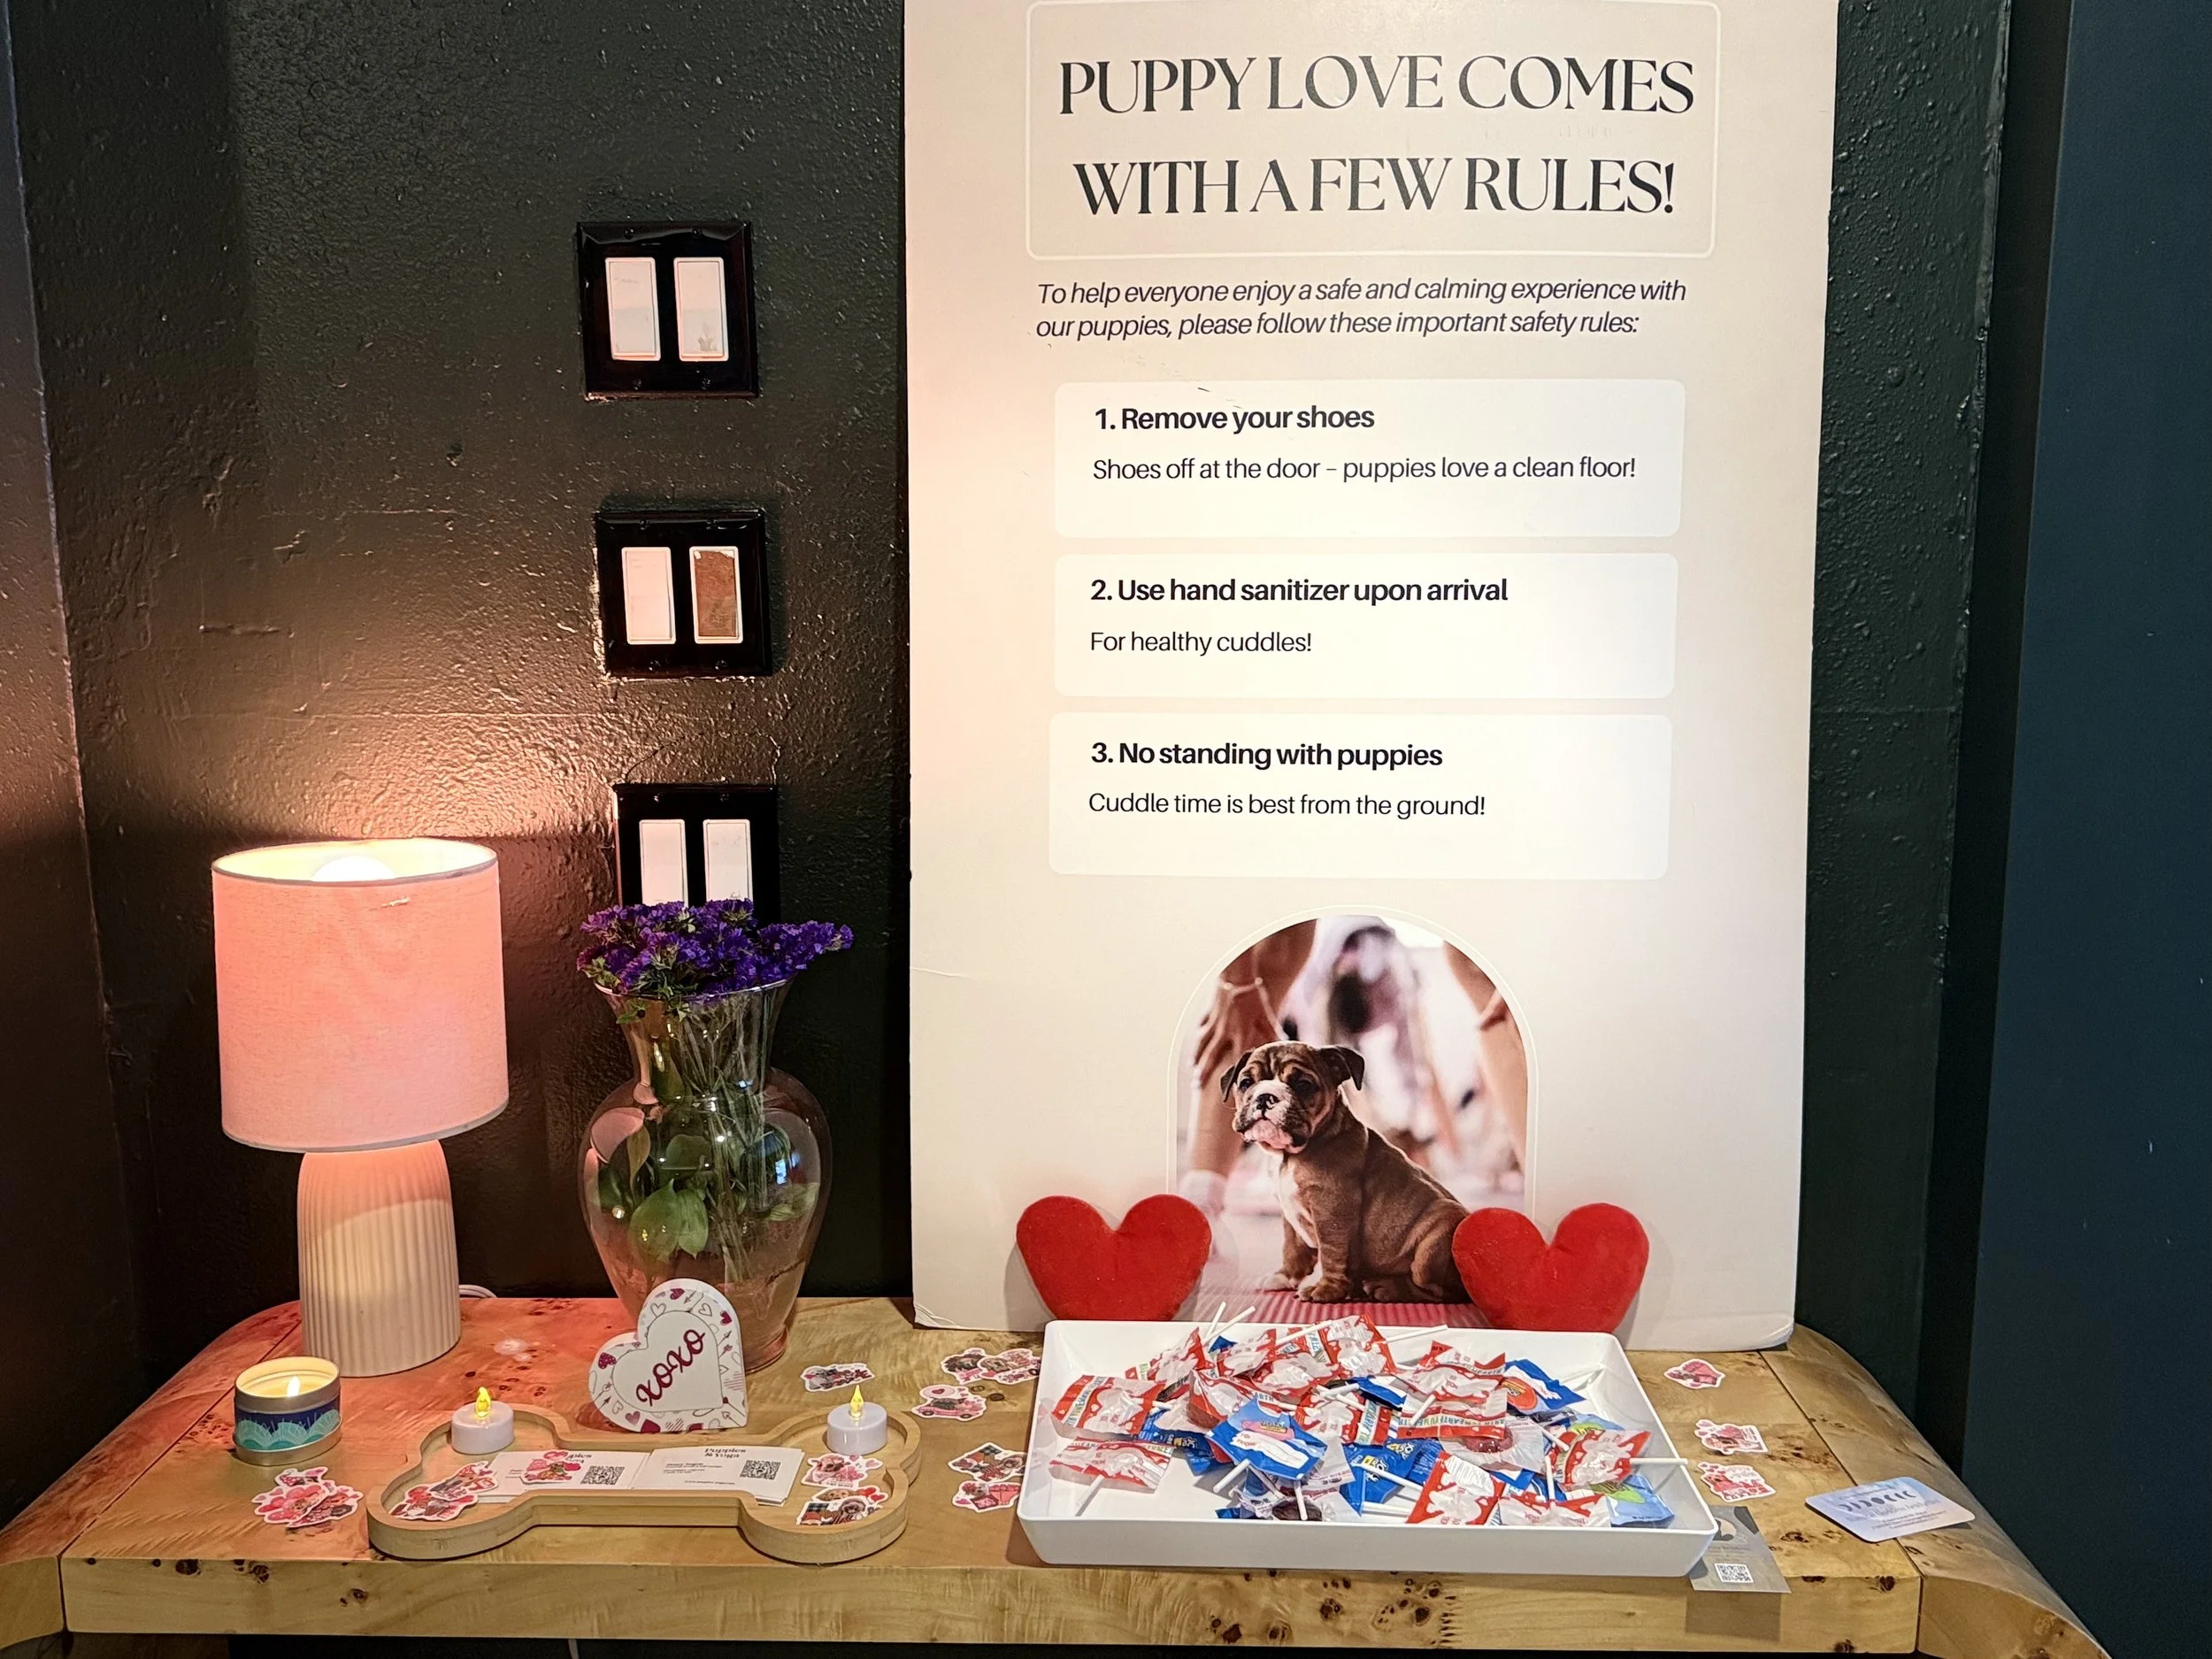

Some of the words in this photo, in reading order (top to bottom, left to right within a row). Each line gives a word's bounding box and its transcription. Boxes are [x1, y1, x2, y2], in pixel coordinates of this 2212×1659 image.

[1059, 57, 1257, 115] PUPPY
[1266, 55, 1444, 110] LOVE
[1458, 55, 1694, 114] COMES
[1072, 159, 1240, 216] WITH
[1248, 158, 1299, 212] A
[1309, 157, 1453, 211] FEW
[1463, 157, 1675, 214] RULES!
[1038, 283, 1067, 304] To
[1070, 281, 1121, 309] help
[1124, 284, 1229, 308] everyone
[1233, 280, 1297, 307] enjoy
[1298, 283, 1312, 301] a
[1315, 277, 1363, 301] safe
[1364, 277, 1412, 300] and
[1414, 277, 1508, 304] calming
[1510, 278, 1636, 304] experience
[1640, 279, 1686, 301] with
[1036, 320, 1076, 337] our
[1076, 314, 1172, 342] puppies,
[1178, 312, 1253, 341] please
[1256, 311, 1327, 334] follow
[1329, 311, 1393, 334] these
[1395, 311, 1508, 338] important
[1509, 310, 1578, 338] safety
[1579, 311, 1640, 334] rules:
[1094, 408, 1117, 430] 1.
[1121, 407, 1228, 430] Remove
[1231, 411, 1294, 435] your
[1295, 404, 1375, 429] shoes
[1093, 457, 1162, 480] Shoes
[1165, 457, 1196, 480] off
[1199, 459, 1221, 480] at
[1225, 457, 1262, 479] the
[1266, 457, 1321, 479] door
[1343, 457, 1436, 483] puppies
[1441, 456, 1489, 478] love
[1494, 461, 1507, 478] a
[1512, 456, 1574, 478] clean
[1578, 455, 1636, 478] floor!
[1090, 579, 1113, 601] 2.
[1118, 579, 1165, 602] Use
[1170, 578, 1236, 602] hand
[1240, 578, 1351, 602] sanitizer
[1354, 583, 1422, 607] upon
[1426, 578, 1509, 602] arrival
[1091, 632, 1126, 652] For
[1131, 630, 1213, 657] healthy
[1216, 631, 1312, 652] cuddles!
[1090, 741, 1114, 764] 3.
[1119, 742, 1156, 764] No
[1158, 741, 1272, 771] standing
[1275, 742, 1333, 765] with
[1337, 743, 1443, 772] puppies
[1088, 792, 1170, 813] Cuddle
[1173, 794, 1222, 814] time
[1226, 794, 1244, 814] is
[1248, 793, 1296, 815] best
[1300, 793, 1351, 815] from
[1356, 794, 1392, 815] the
[1396, 795, 1486, 820] ground!
